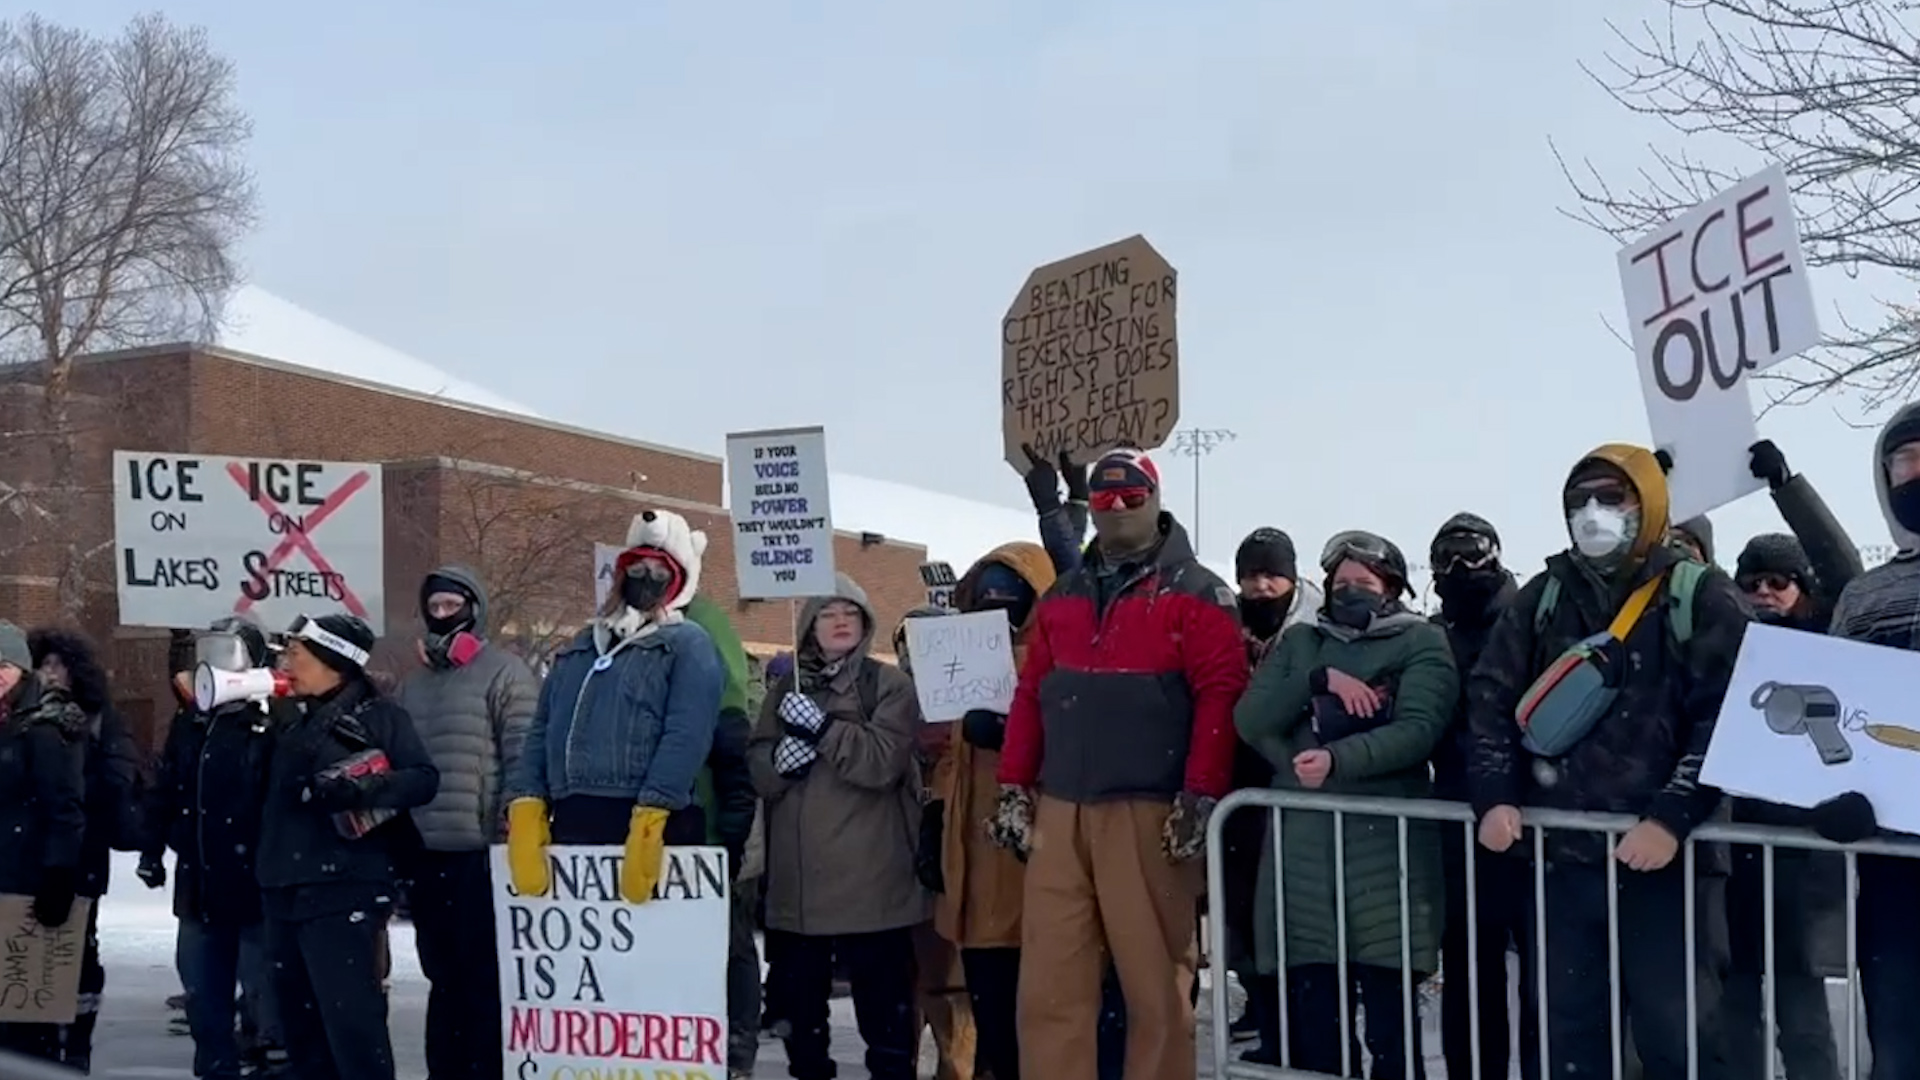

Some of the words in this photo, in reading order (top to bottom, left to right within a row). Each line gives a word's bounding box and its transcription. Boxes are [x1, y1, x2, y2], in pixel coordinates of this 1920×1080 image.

[1631, 185, 1785, 328] ICE
[1030, 257, 1130, 312] BEATING
[1003, 291, 1115, 345] CITIZENS
[1130, 275, 1175, 314] FOR
[1652, 264, 1792, 403] OUT
[1016, 314, 1160, 374] EXERCISING
[1003, 356, 1100, 406] RIGHTS?
[1114, 338, 1174, 379] DOES
[1016, 396, 1071, 430] THIS
[1087, 378, 1146, 418] FEEL
[1034, 398, 1169, 457] AMERICAN?
[754, 448, 763, 459] IF
[767, 445, 797, 458] YOUR
[754, 461, 799, 478] VOICE
[128, 459, 203, 502] ICE
[249, 463, 325, 505] ICE
[755, 483, 782, 496] HELD
[784, 482, 799, 494] NO
[151, 511, 186, 531] ON
[268, 512, 305, 534] ON
[737, 520, 765, 533] THEY
[768, 517, 825, 531] WOULDN'T
[751, 498, 808, 515] POWER
[751, 548, 813, 566] SILENCE
[762, 535, 782, 546] TRY
[785, 534, 800, 546] TO
[124, 548, 219, 590] LAKES
[240, 550, 345, 601] STREETS
[773, 569, 796, 582] YOU
[506, 853, 725, 901] NATAN
[508, 905, 634, 953] ROSS
[0, 937, 29, 1009] SAME
[515, 954, 556, 1001] IS
[573, 956, 605, 1002] A
[508, 1005, 723, 1065] MURDERER
